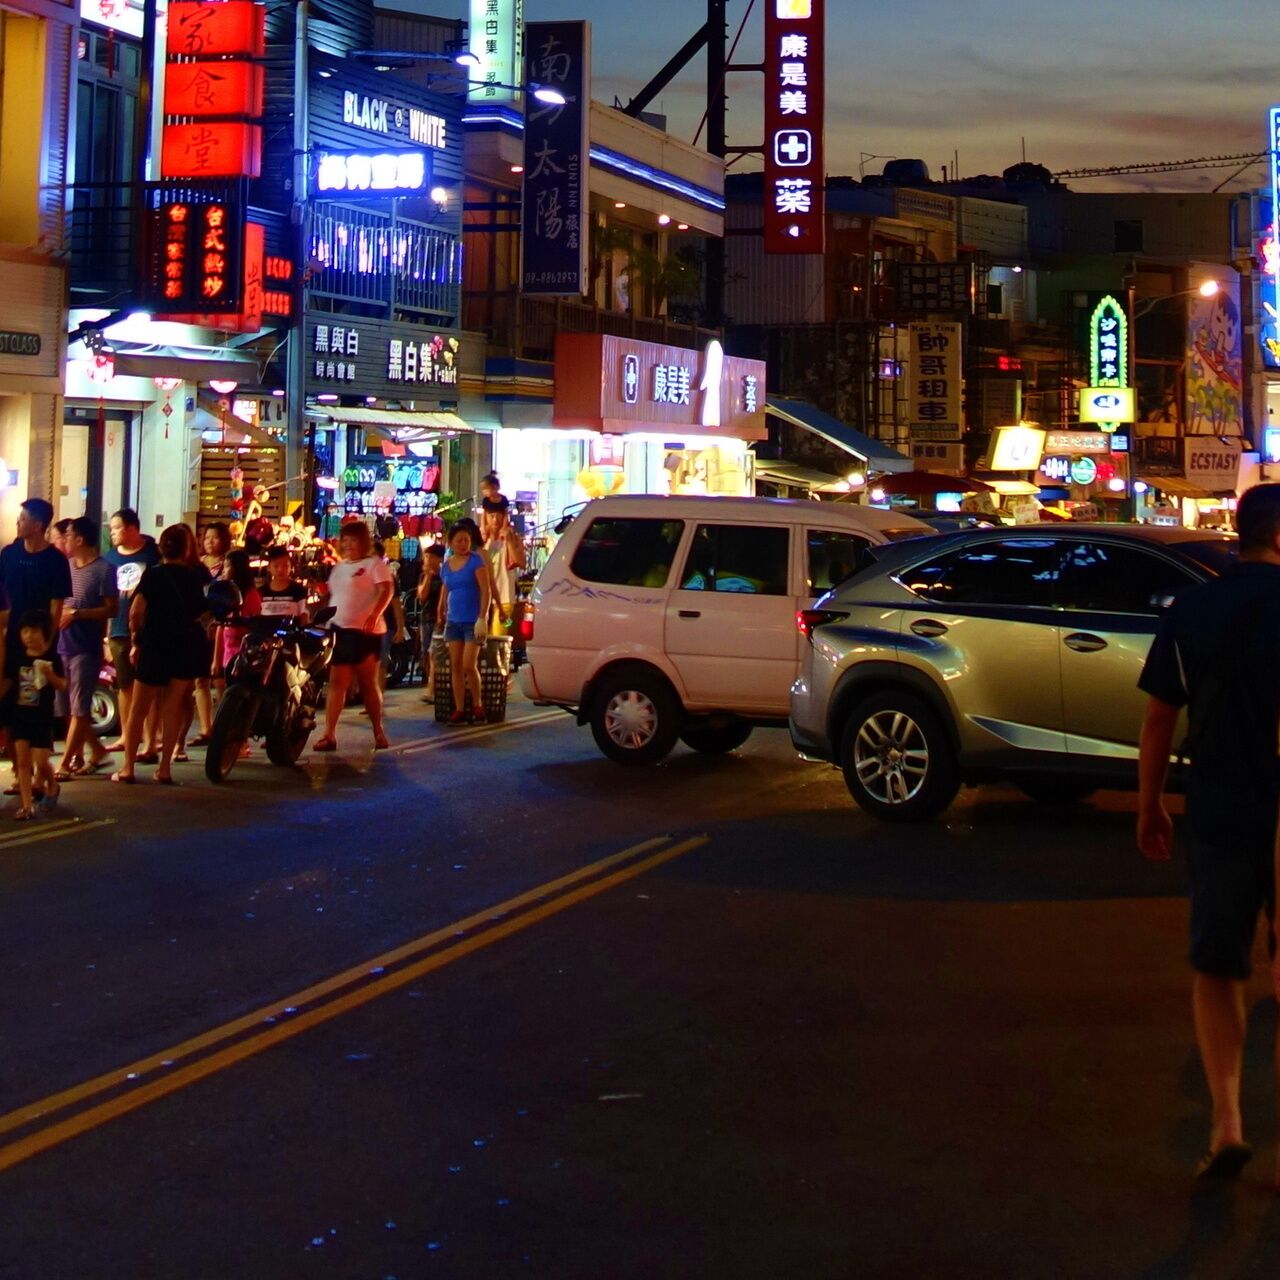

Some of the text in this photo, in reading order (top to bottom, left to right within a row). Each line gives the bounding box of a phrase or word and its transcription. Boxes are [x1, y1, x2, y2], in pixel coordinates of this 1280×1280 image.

[779, 32, 809, 116] 康是美
[343, 90, 389, 133] BLACK
[409, 108, 447, 149] WHITE
[527, 34, 572, 241] 南太陽
[11, 334, 40, 354] CLASS
[315, 324, 360, 357] 黑與白
[388, 339, 432, 383] 黑白集
[653, 363, 691, 406] 康是美
[1189, 451, 1239, 471] ECSTASY
